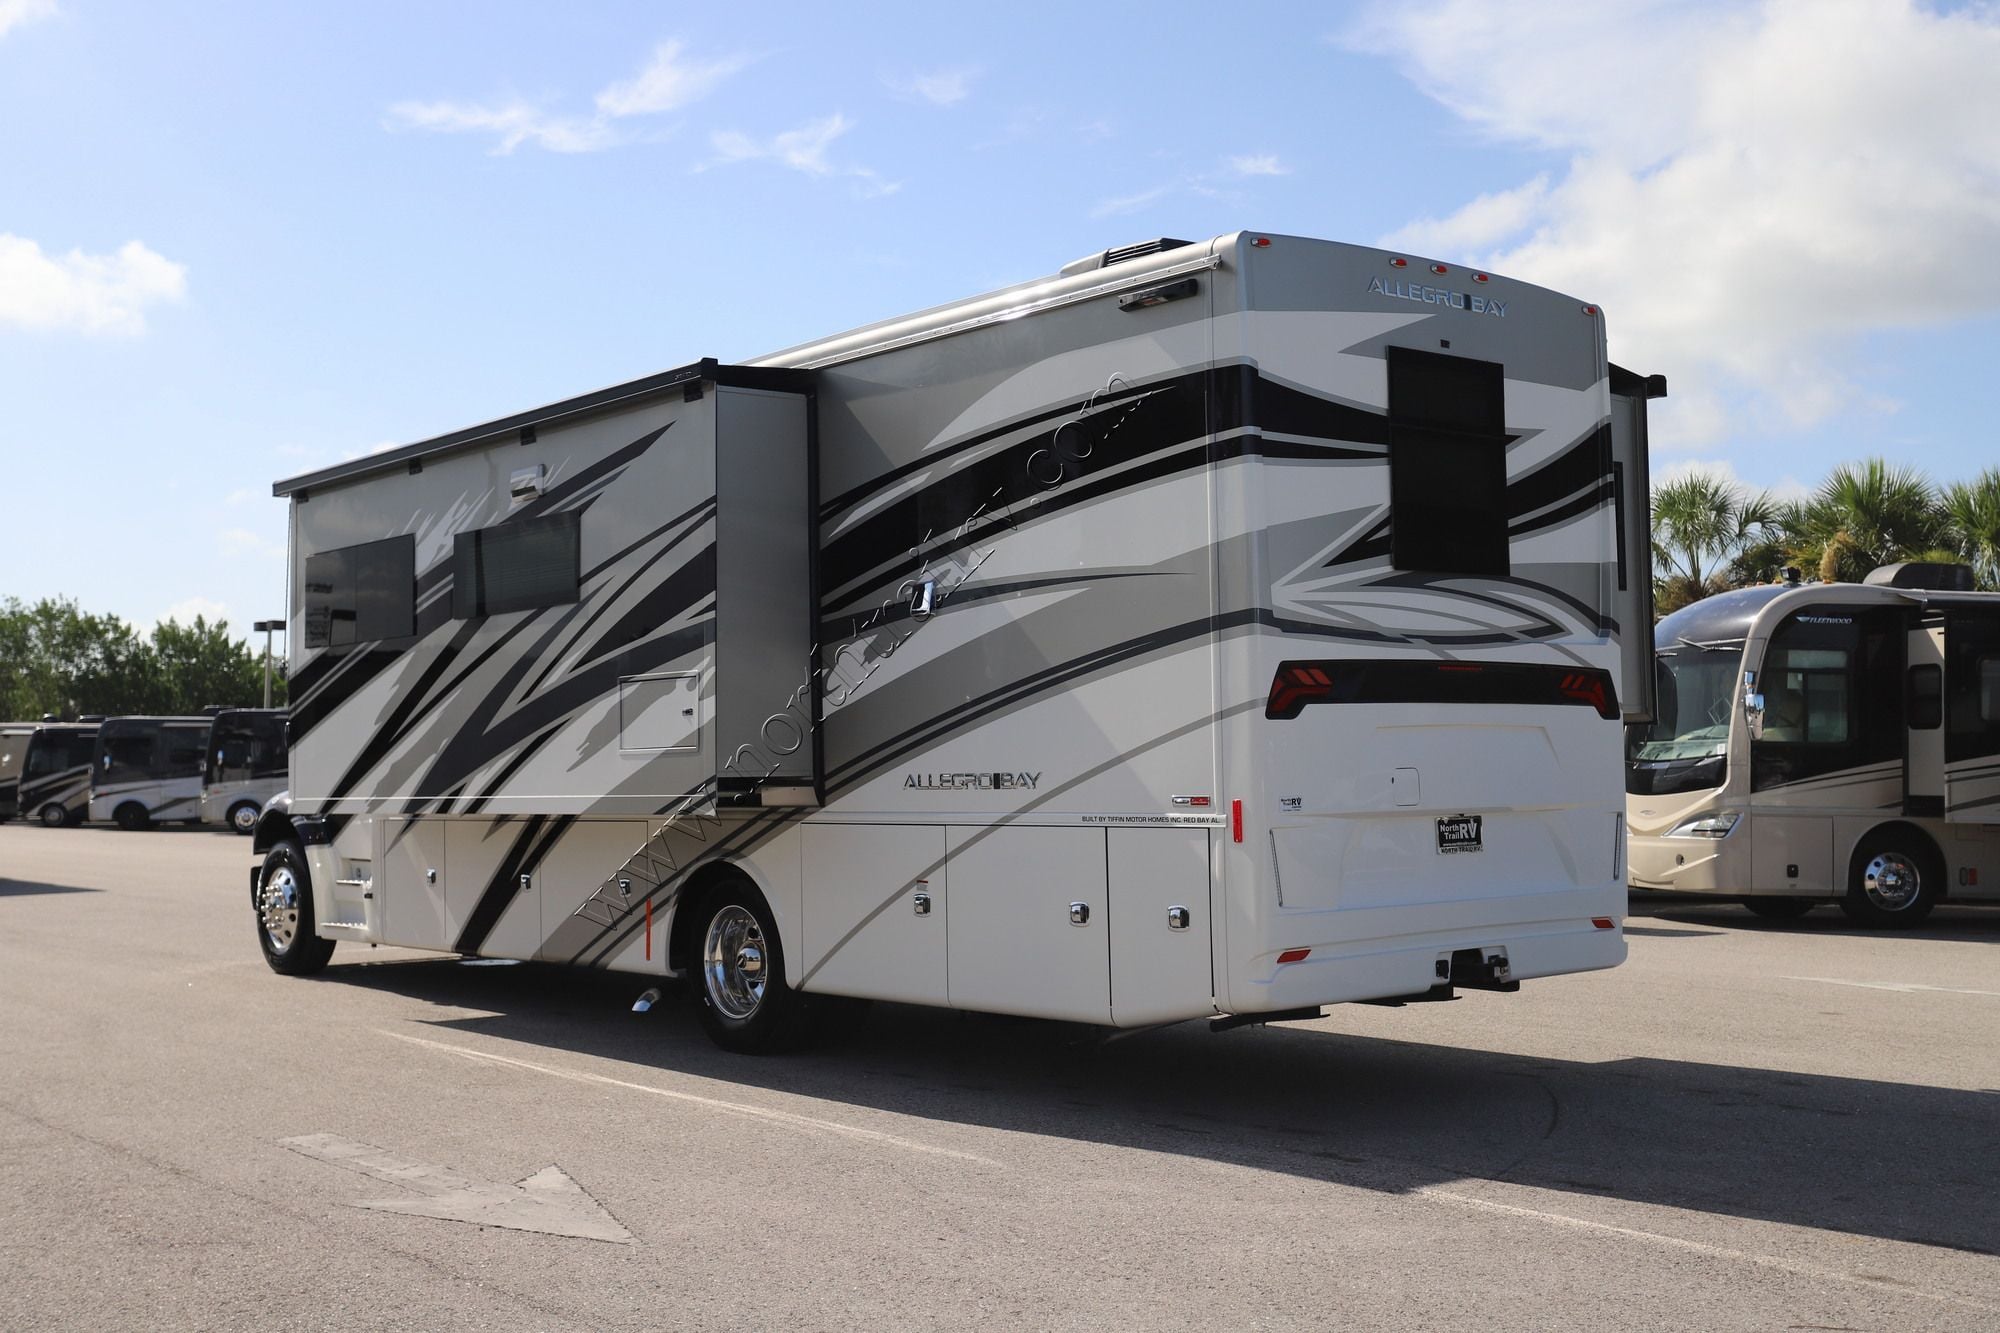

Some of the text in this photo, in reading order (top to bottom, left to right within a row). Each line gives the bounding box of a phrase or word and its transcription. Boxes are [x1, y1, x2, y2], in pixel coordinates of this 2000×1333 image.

[1367, 276, 1508, 318] ALLEGRO BAY
[1809, 617, 1853, 625] FLEETWOOD
[903, 771, 1042, 790] ALLEGRO BAY
[1125, 816, 1147, 824] MOTOR
[1440, 822, 1477, 839] North RV
[1444, 832, 1459, 840] Trail
